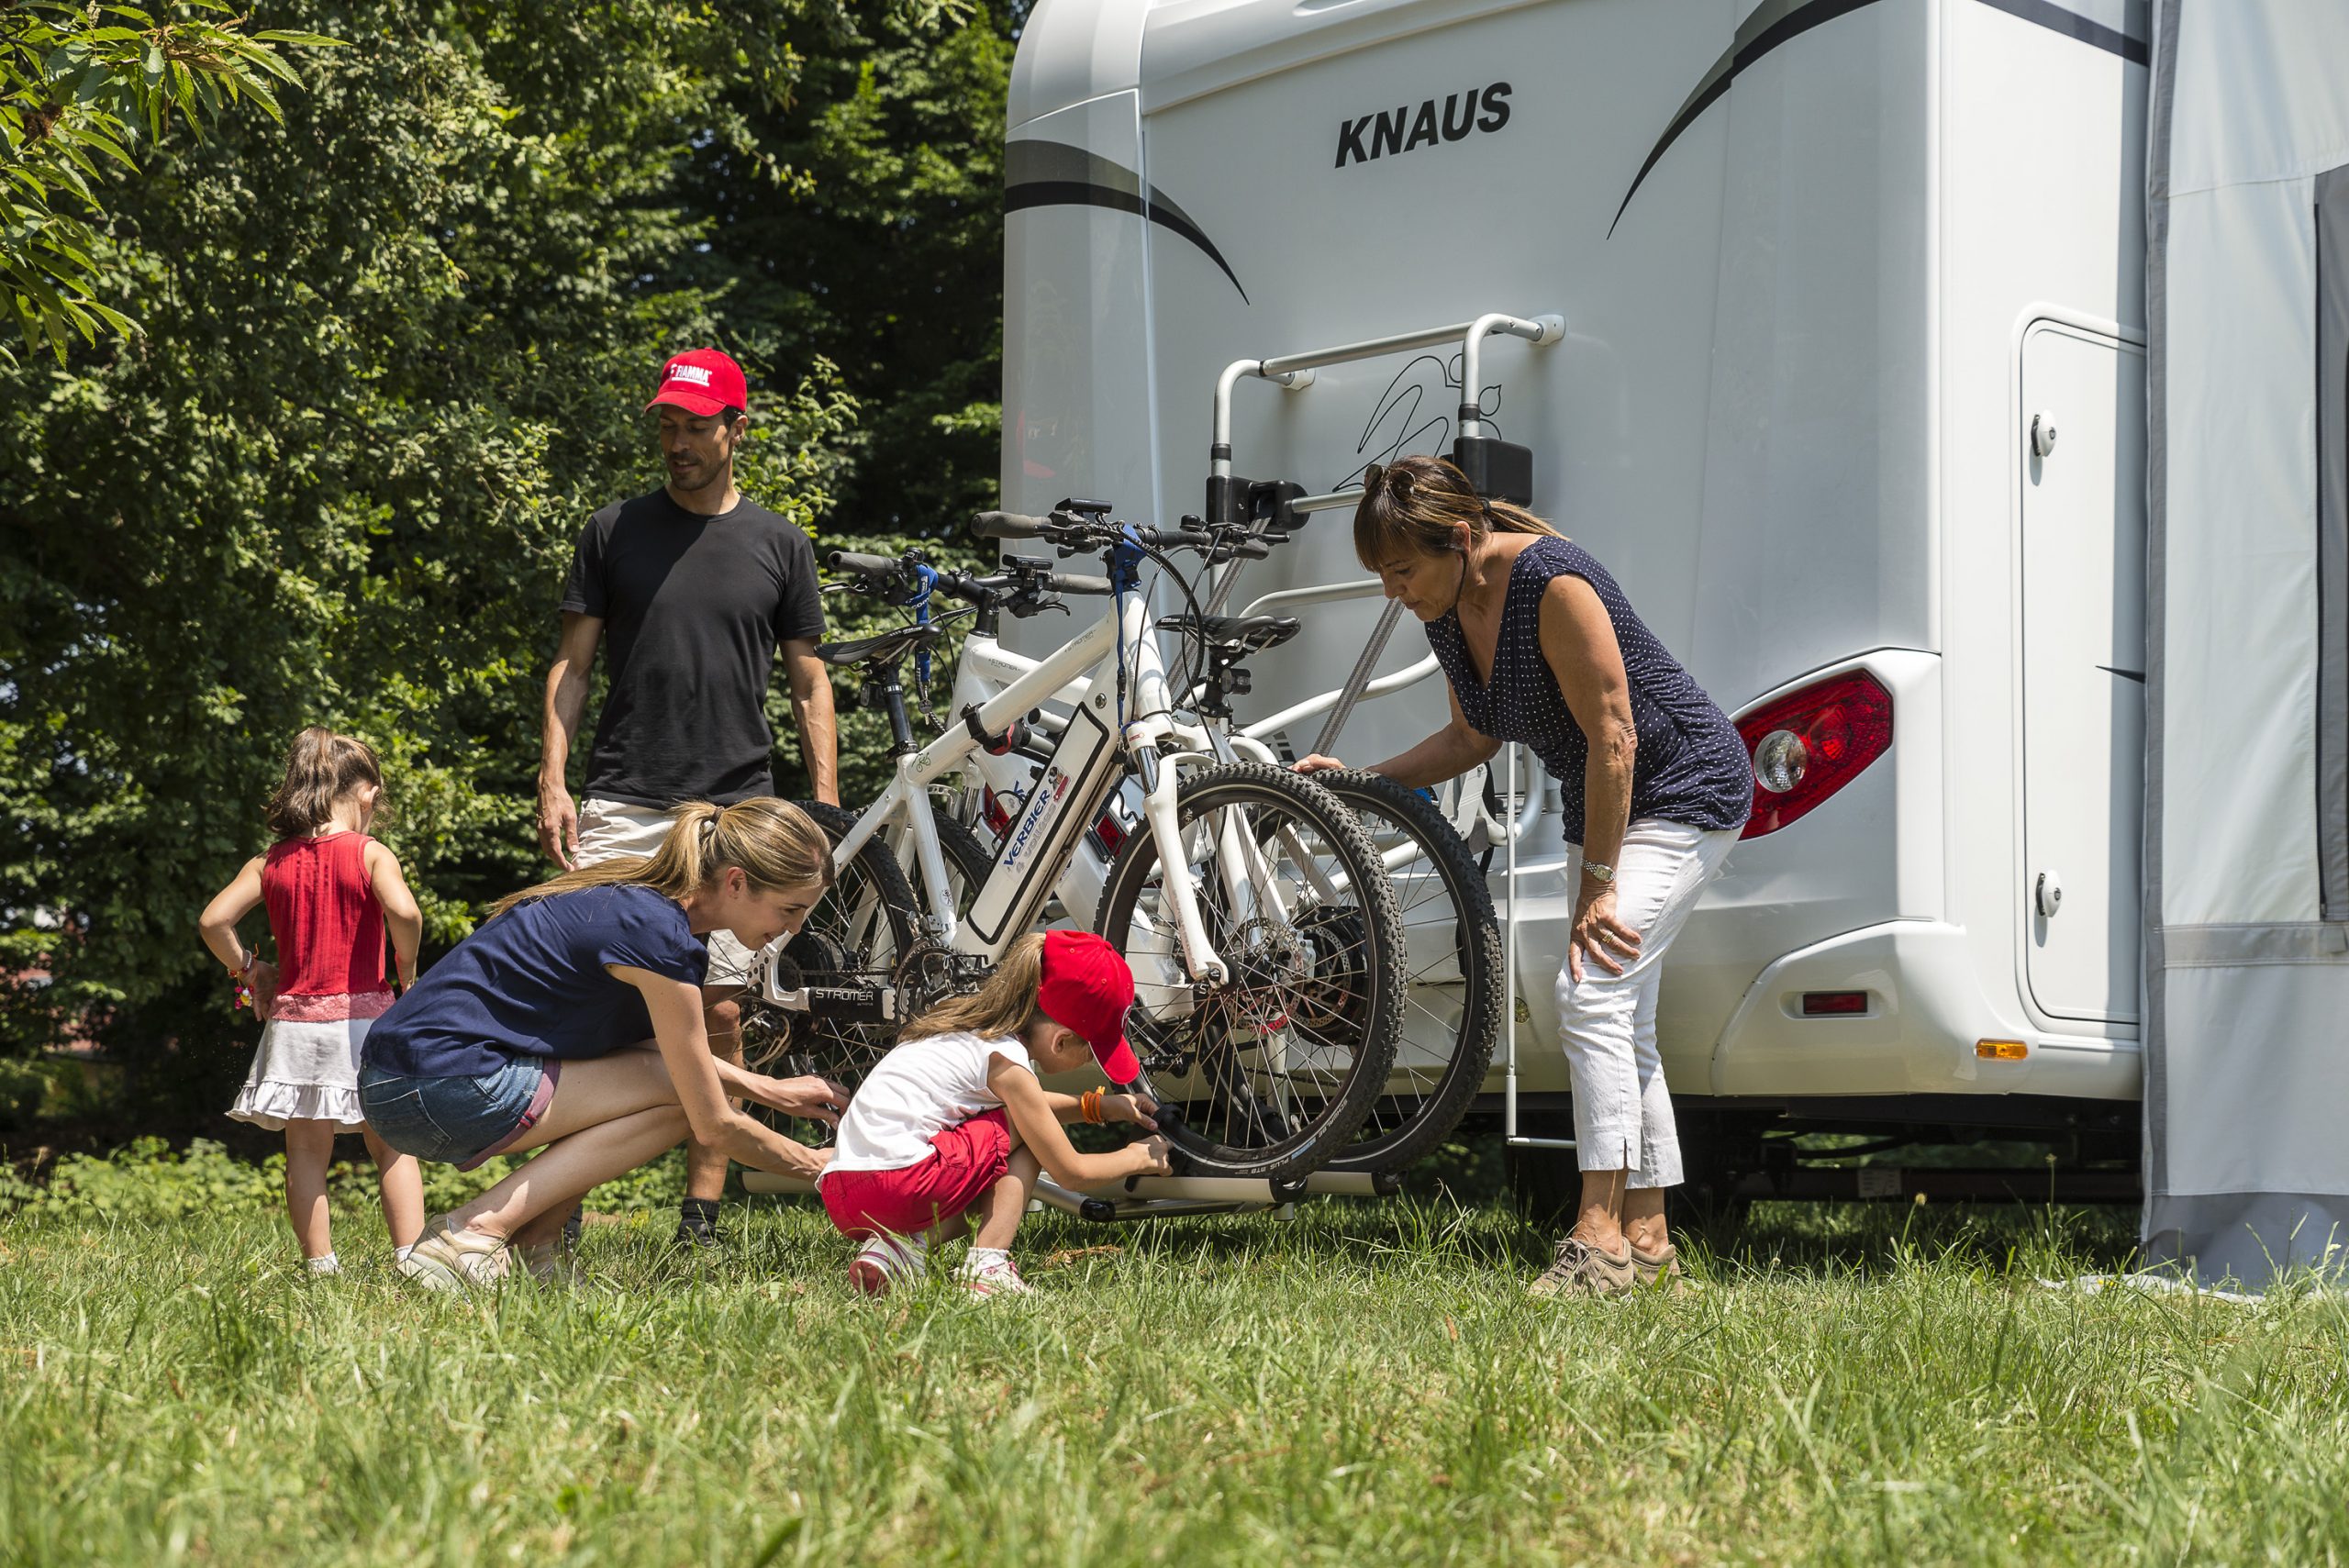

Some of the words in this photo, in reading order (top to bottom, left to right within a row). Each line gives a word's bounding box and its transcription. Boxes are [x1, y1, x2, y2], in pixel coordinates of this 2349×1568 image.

[1335, 82, 1512, 169] KNAUS
[674, 365, 709, 383] FIAMMA
[1003, 789, 1051, 866] VERBIER
[816, 988, 874, 1001] STROMER
